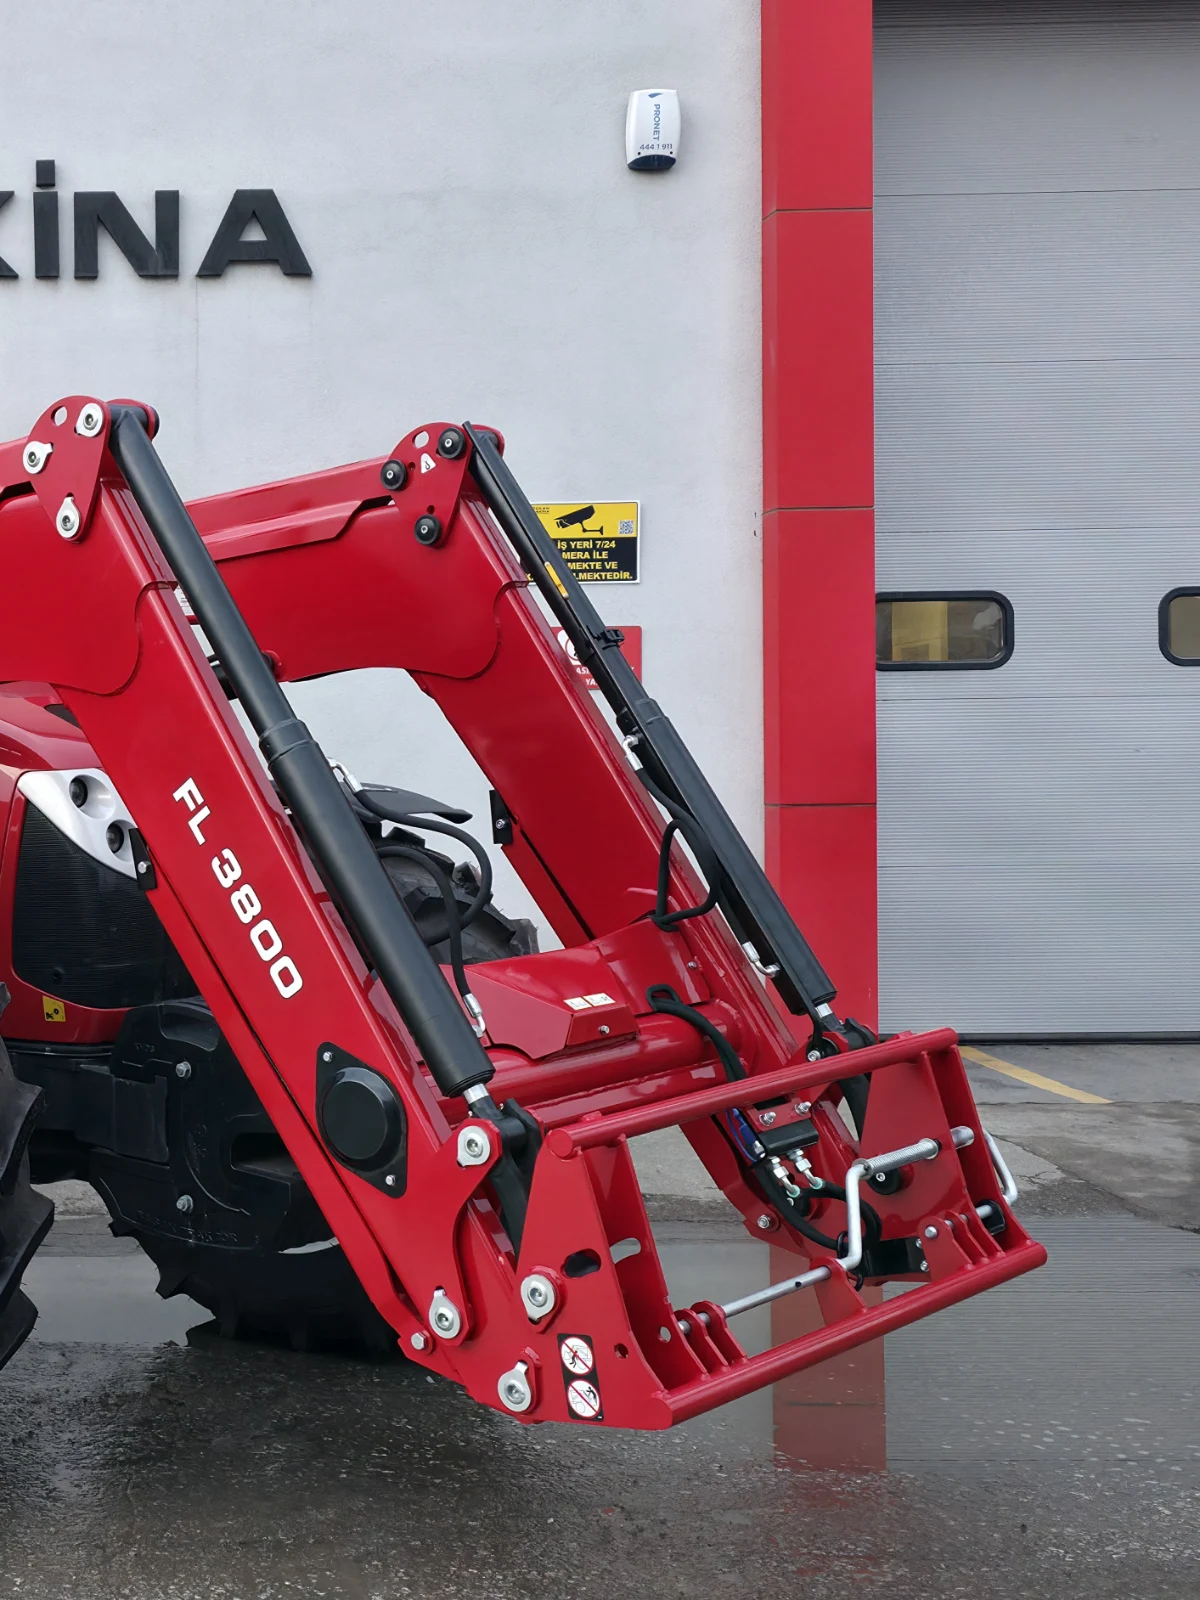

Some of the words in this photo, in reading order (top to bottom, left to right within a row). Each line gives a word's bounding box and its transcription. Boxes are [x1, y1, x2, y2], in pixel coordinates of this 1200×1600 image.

[653, 104, 661, 141] PRONET
[570, 539, 593, 549] YERİ
[596, 540, 616, 549] 7/24
[562, 551, 590, 559] MERA
[593, 550, 608, 559] İLE
[568, 562, 602, 570] MEKTE
[604, 561, 618, 569] VE
[172, 777, 211, 846] FL
[211, 847, 304, 999] 3800
